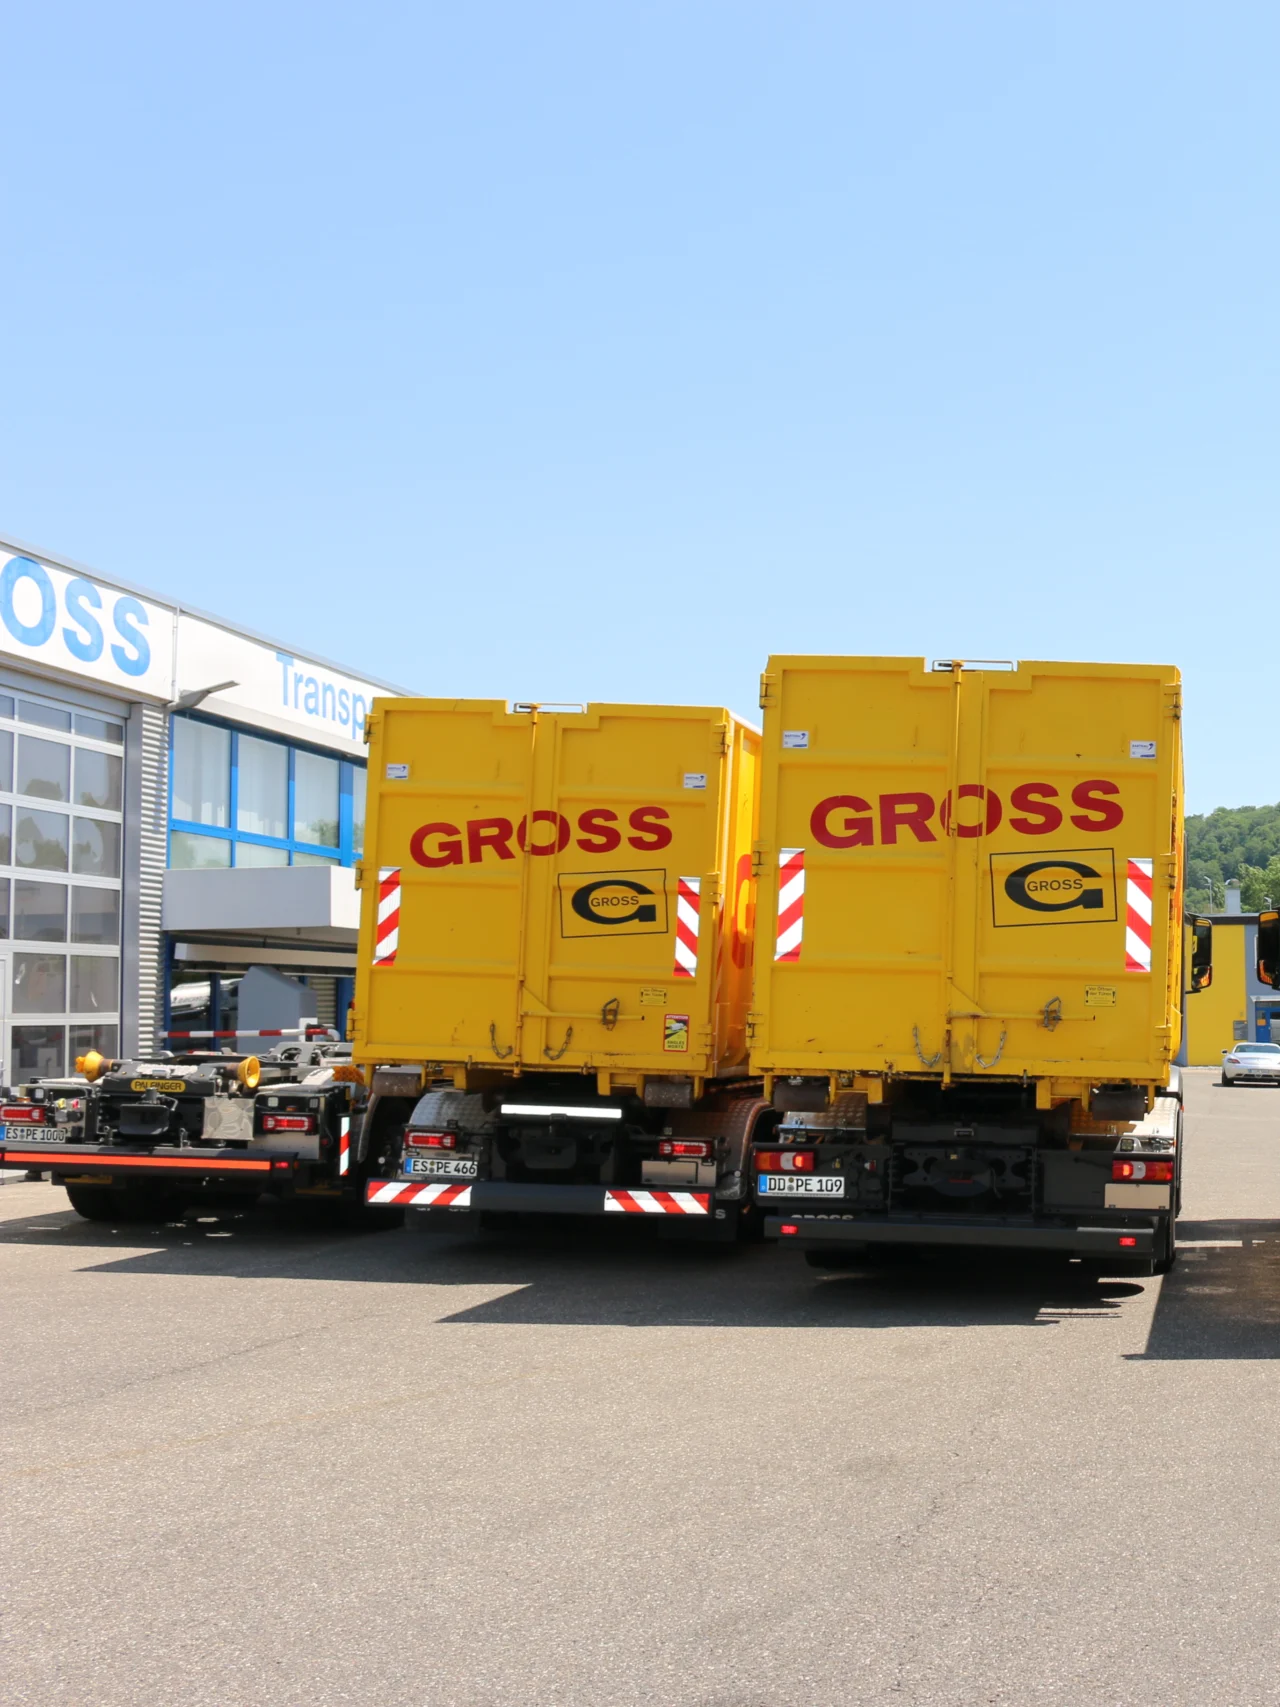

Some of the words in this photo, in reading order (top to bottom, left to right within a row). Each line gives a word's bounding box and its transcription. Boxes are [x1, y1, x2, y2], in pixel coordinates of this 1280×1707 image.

[0, 556, 151, 677] OSS
[276, 652, 372, 740] Transp
[807, 779, 1124, 849] GROSS
[409, 806, 673, 868] GROSS
[1027, 878, 1083, 892] GROSS
[590, 895, 639, 907] GROSS
[6, 1128, 18, 1139] ES
[26, 1129, 38, 1140] PE
[413, 1160, 428, 1172] ES
[436, 1161, 451, 1173] PE
[454, 1163, 476, 1174] 466
[769, 1178, 786, 1191] DD
[796, 1179, 813, 1192] PE
[817, 1179, 842, 1192] 109
